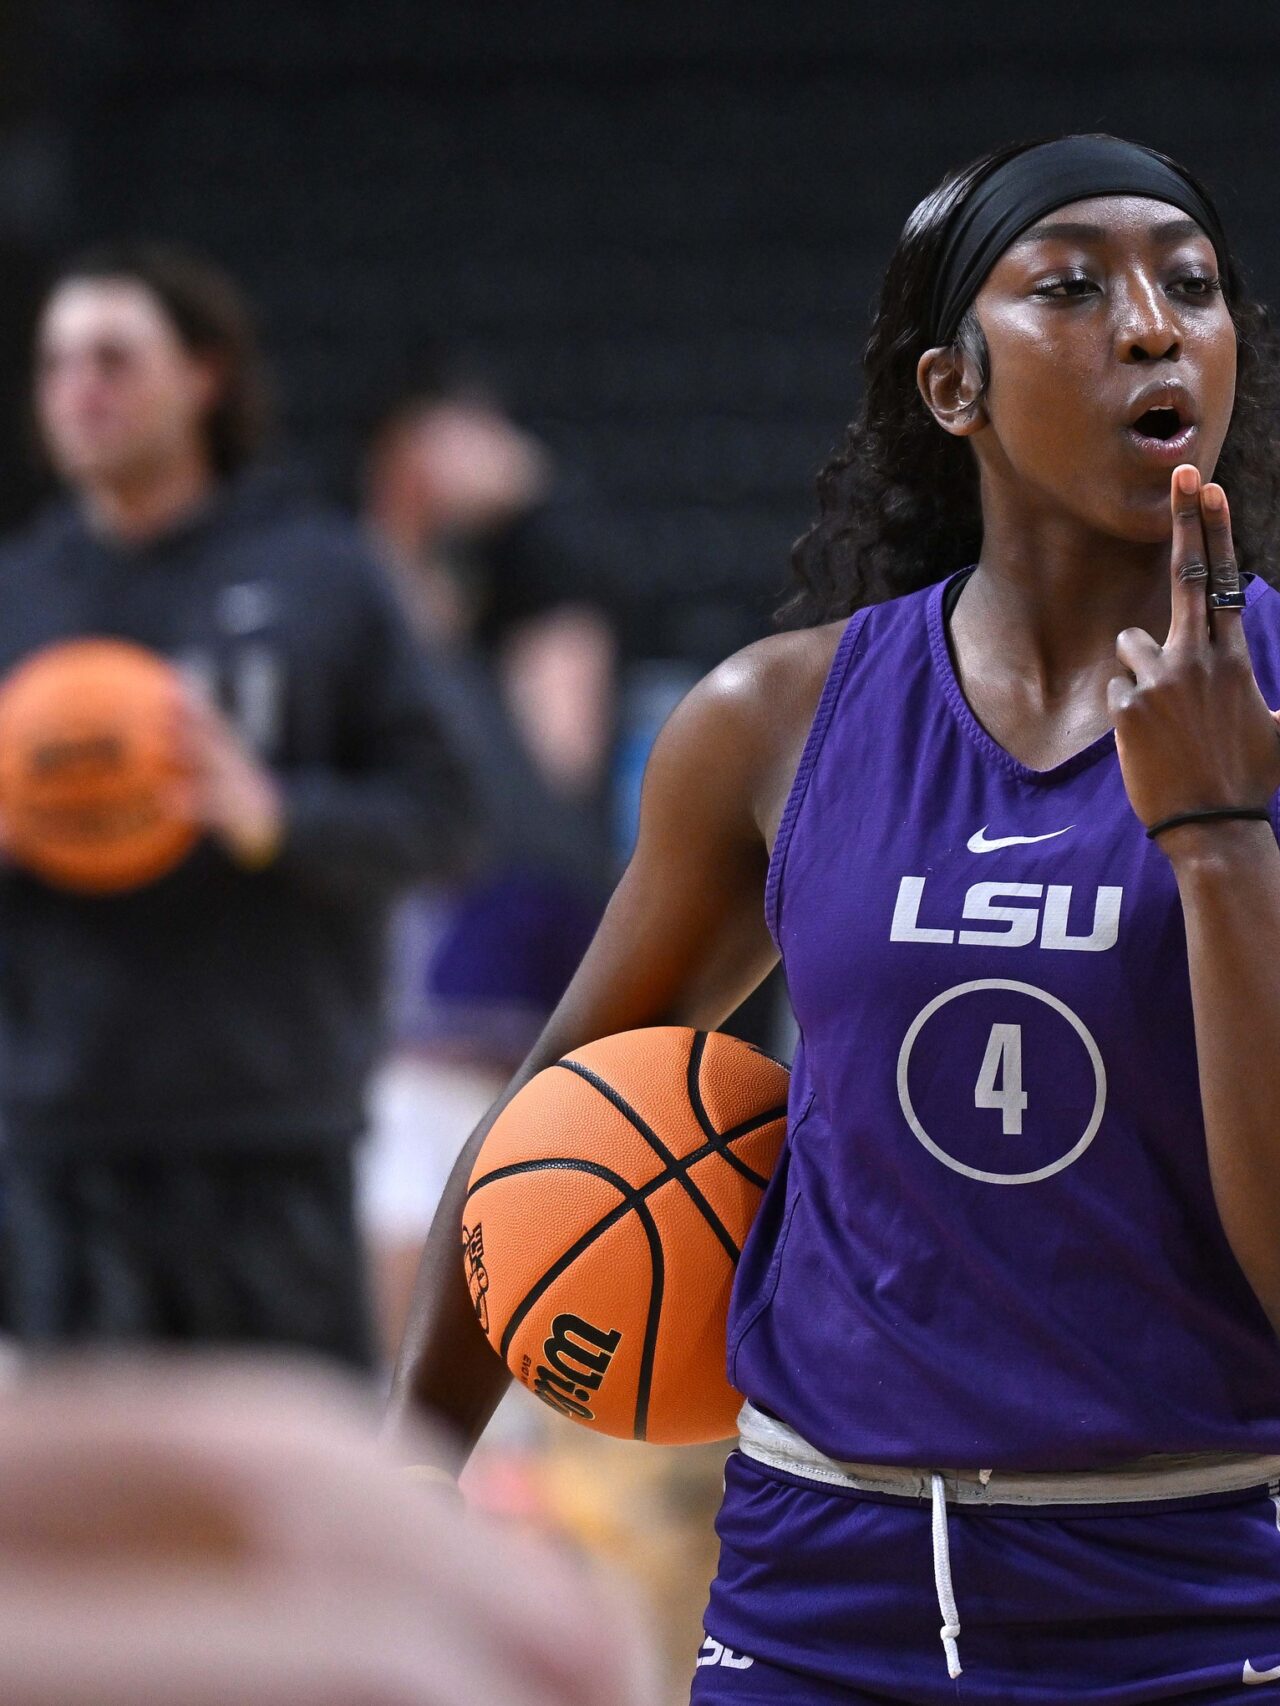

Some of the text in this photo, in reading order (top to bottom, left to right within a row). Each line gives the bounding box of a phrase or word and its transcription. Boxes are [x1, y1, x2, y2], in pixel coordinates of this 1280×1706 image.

[890, 876, 1123, 951] LSU
[974, 1023, 1029, 1135] 4
[534, 1313, 623, 1420] Wil
